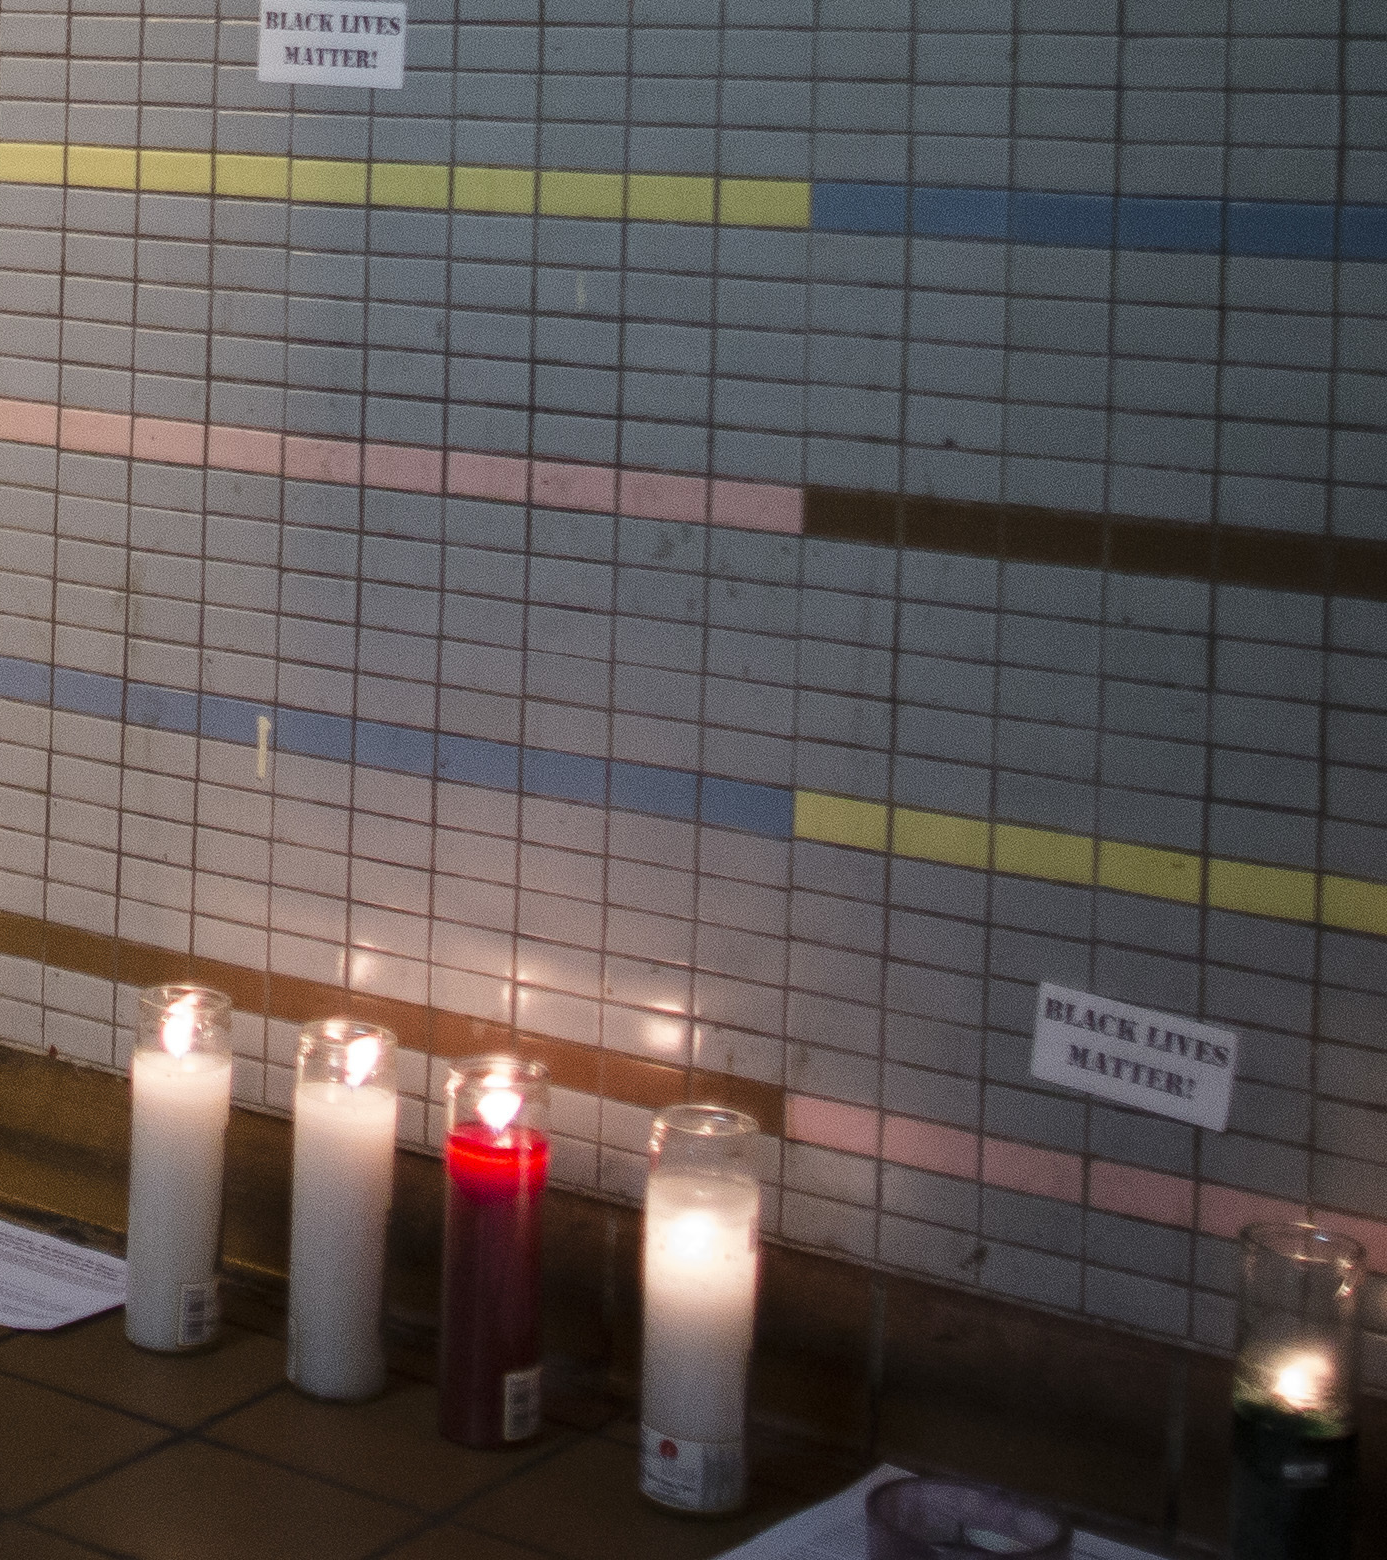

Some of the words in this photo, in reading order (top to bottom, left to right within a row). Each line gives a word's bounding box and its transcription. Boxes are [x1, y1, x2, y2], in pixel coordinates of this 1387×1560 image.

[265, 11, 333, 33] BLACK
[340, 14, 401, 36] LIVES
[284, 46, 378, 69] MATTER!
[1045, 997, 1138, 1043] BLACK
[1147, 1026, 1231, 1068] LIVES
[1068, 1044, 1197, 1100] MATTER!
